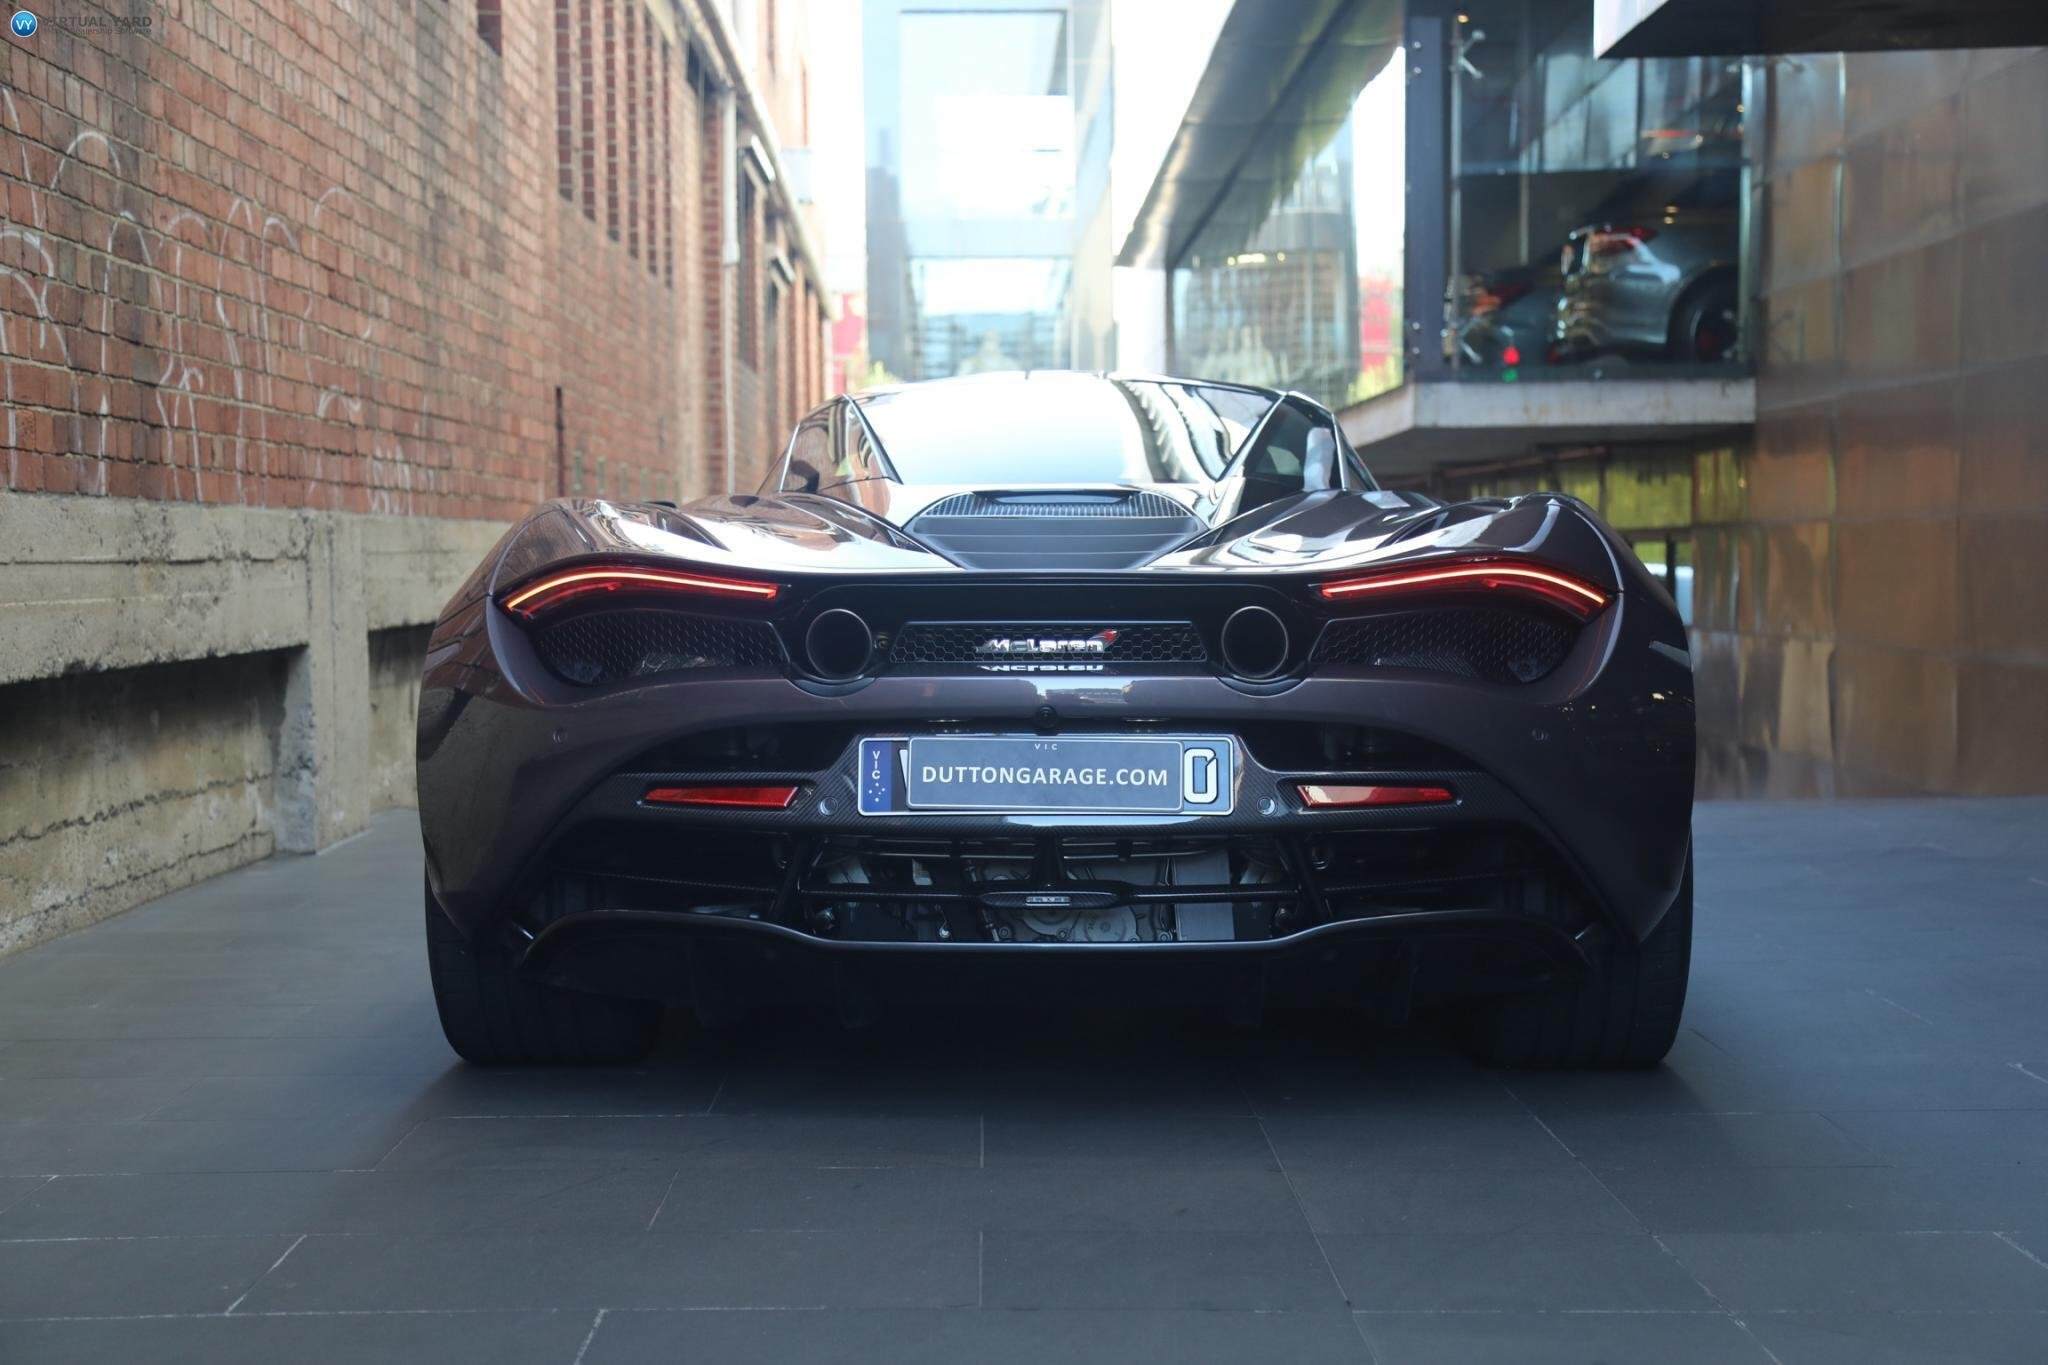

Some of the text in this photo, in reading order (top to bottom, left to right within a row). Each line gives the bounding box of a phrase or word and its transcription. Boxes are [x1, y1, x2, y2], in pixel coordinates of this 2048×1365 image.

[978, 636, 1105, 653] McLaren
[1034, 743, 1059, 751] VIC
[872, 750, 881, 780] VIC
[921, 765, 1169, 787] DUTTONGARAGE.COM
